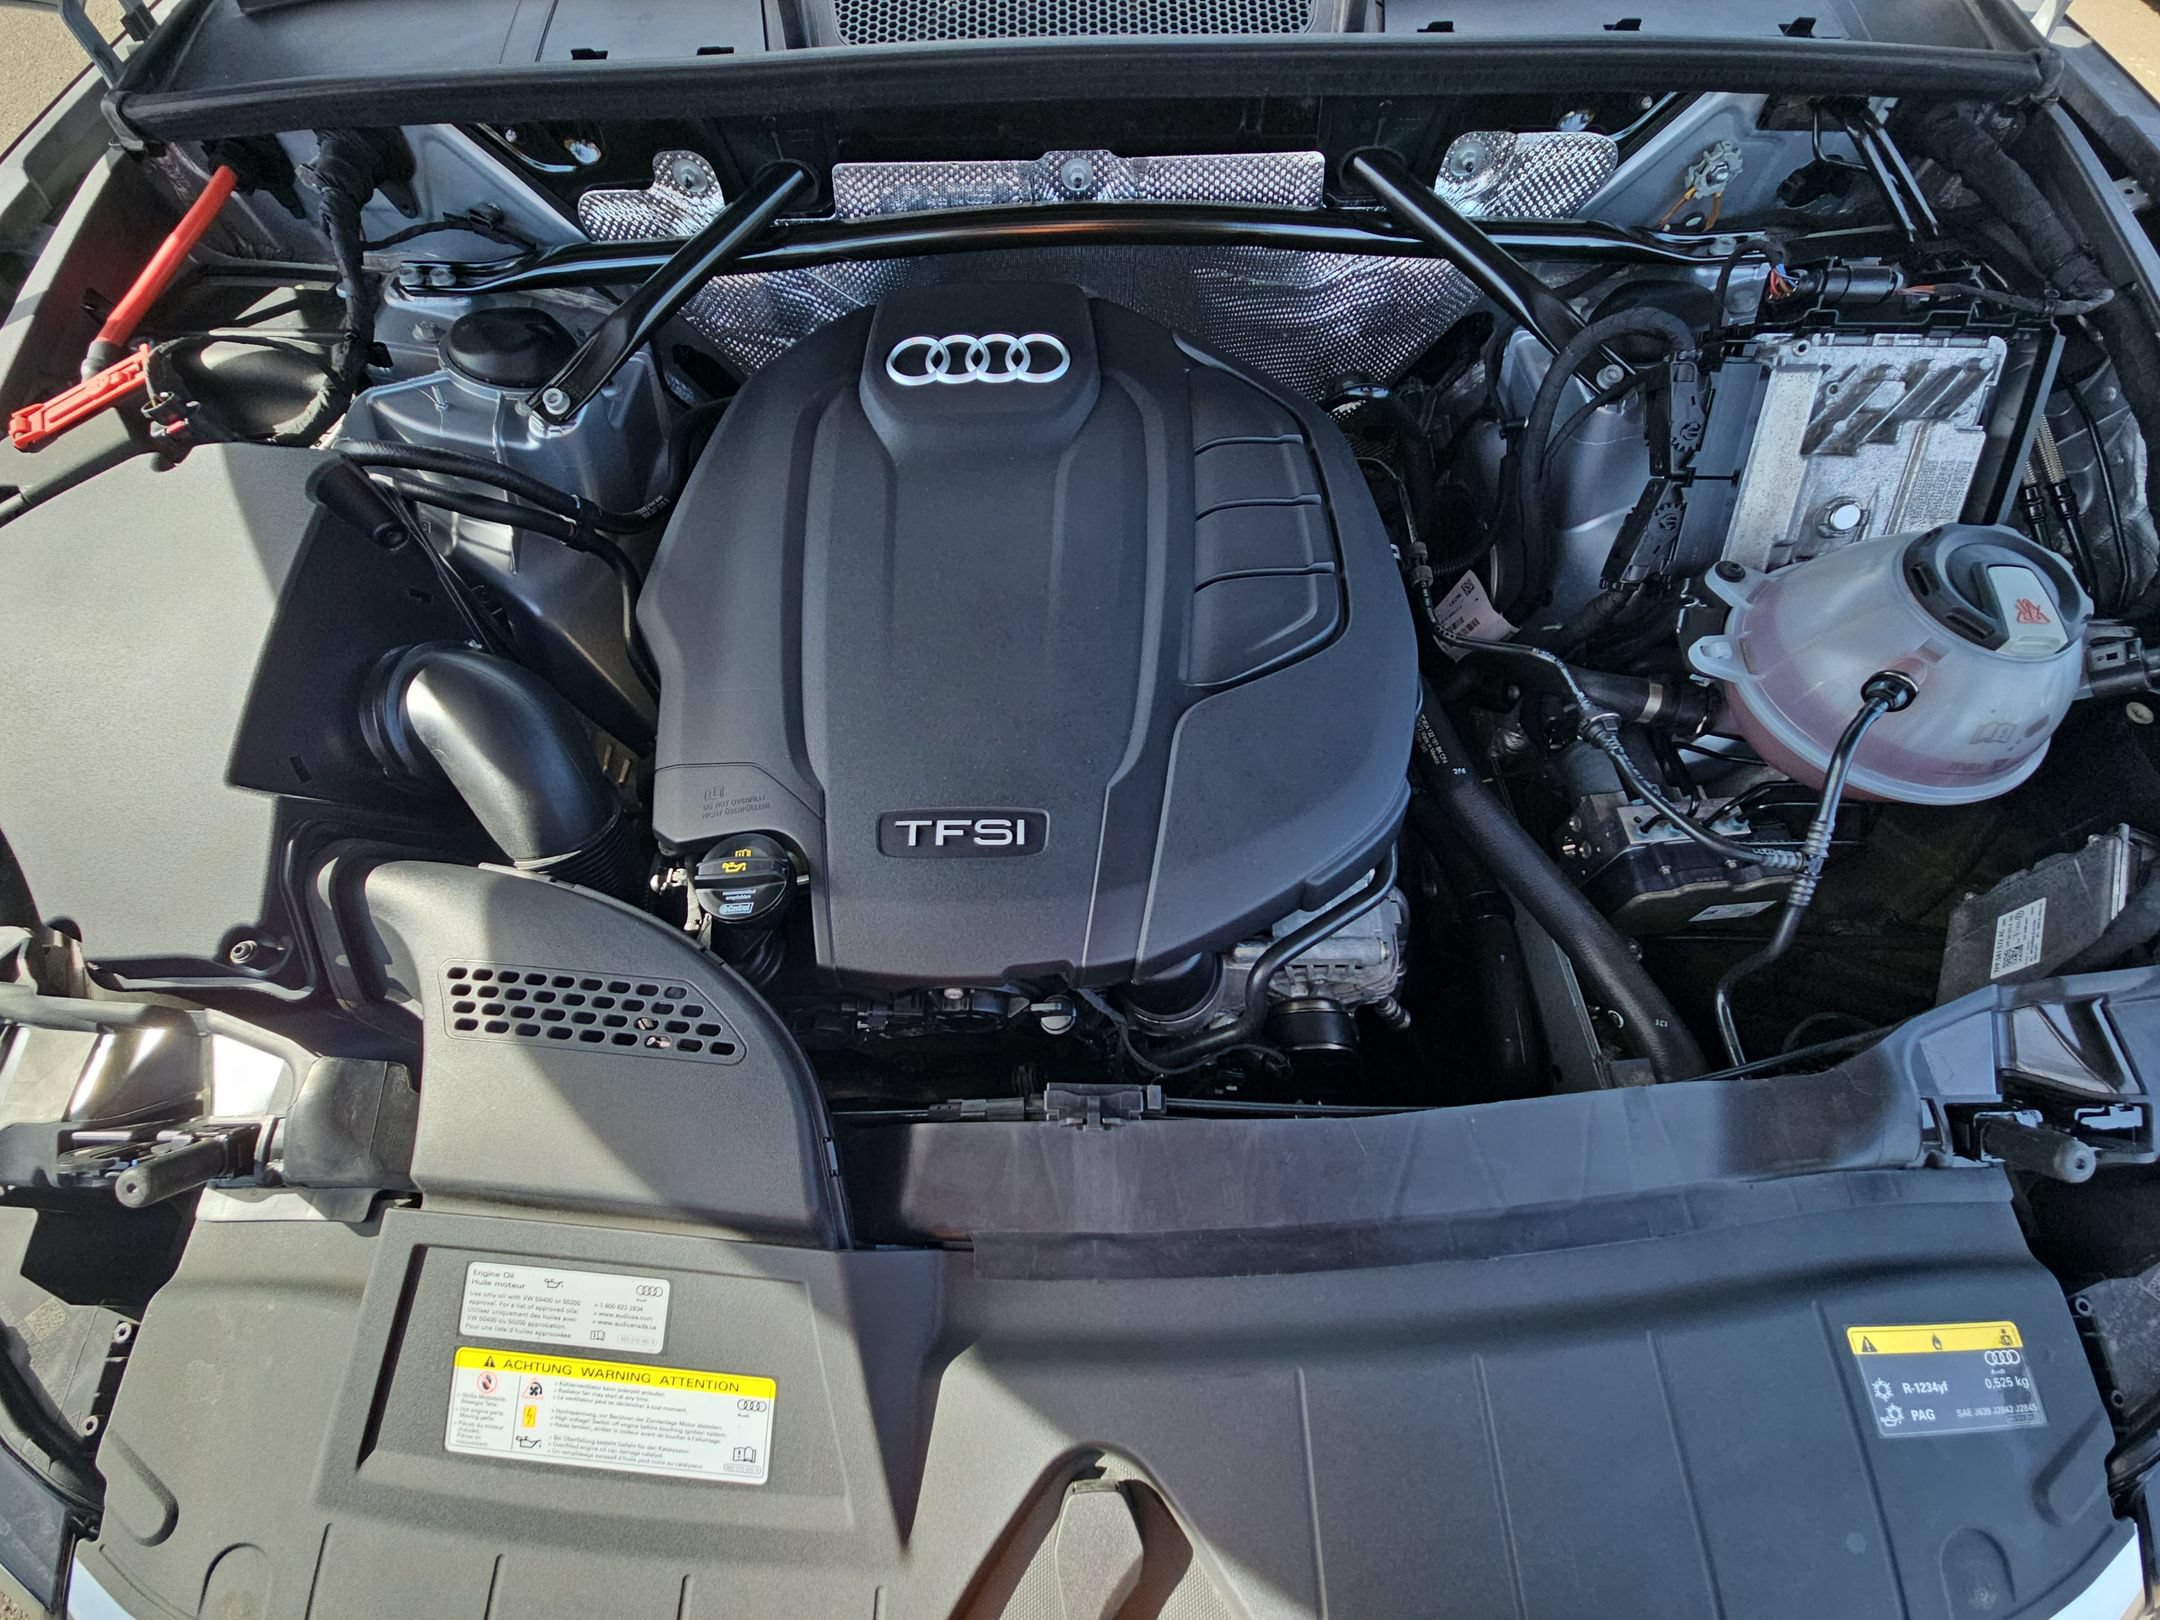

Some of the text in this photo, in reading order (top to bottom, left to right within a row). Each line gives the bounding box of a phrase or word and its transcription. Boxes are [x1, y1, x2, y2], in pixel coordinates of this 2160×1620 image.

[895, 819, 1025, 847] TFSI
[473, 1269, 515, 1279] Engine Oil
[471, 1279, 526, 1289] Huile moteur
[503, 1359, 740, 1393] ACHTUNG WARNING ATTENTION
[1901, 1380, 1949, 1395] R-1234yf
[2015, 1375, 2030, 1389] kg
[1910, 1408, 1937, 1421] PAG
[1956, 1408, 1973, 1418] SAE
